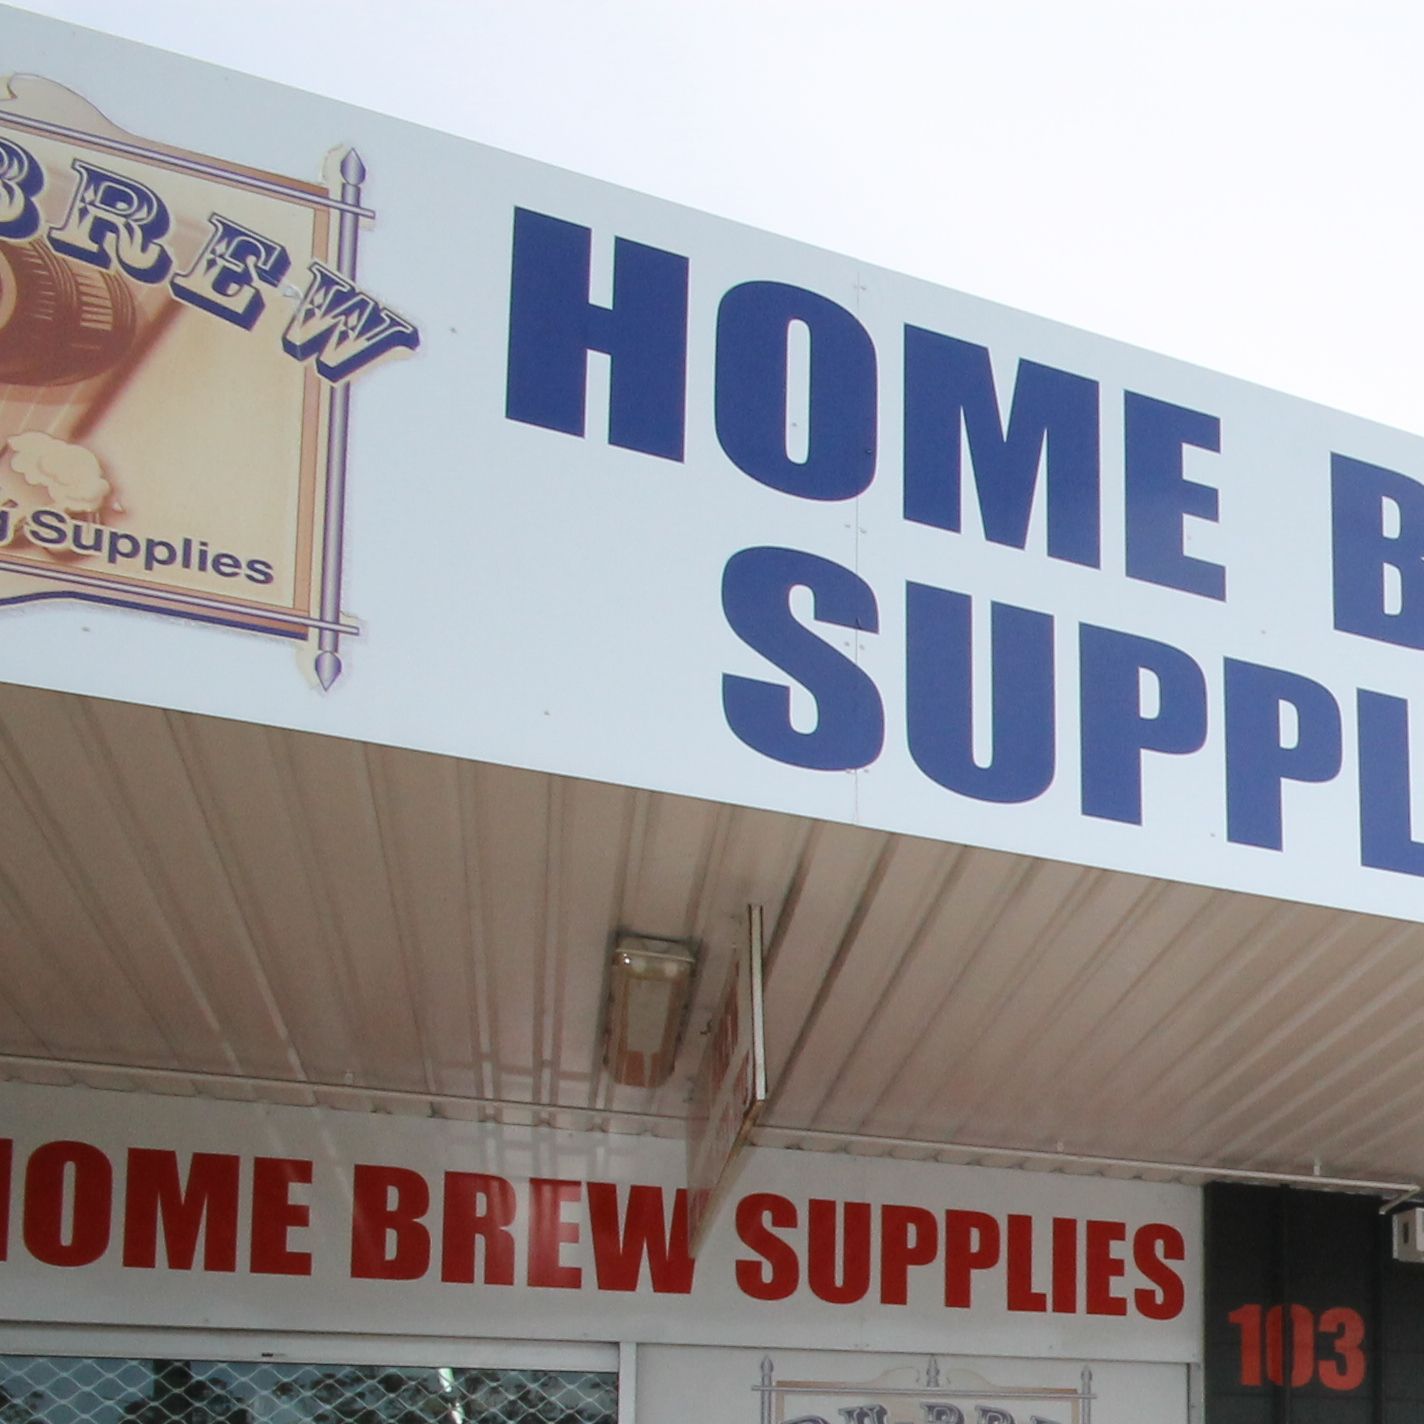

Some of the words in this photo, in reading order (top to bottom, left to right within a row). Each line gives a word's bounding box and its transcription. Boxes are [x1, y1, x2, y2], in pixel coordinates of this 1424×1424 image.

[505, 205, 1227, 603] HOME
[29, 509, 275, 586] Supplies
[0, 1138, 313, 1277] OME
[350, 1164, 698, 1295] BREW
[735, 1193, 1187, 1321] SUPPLIES
[1227, 1302, 1368, 1392] 103
